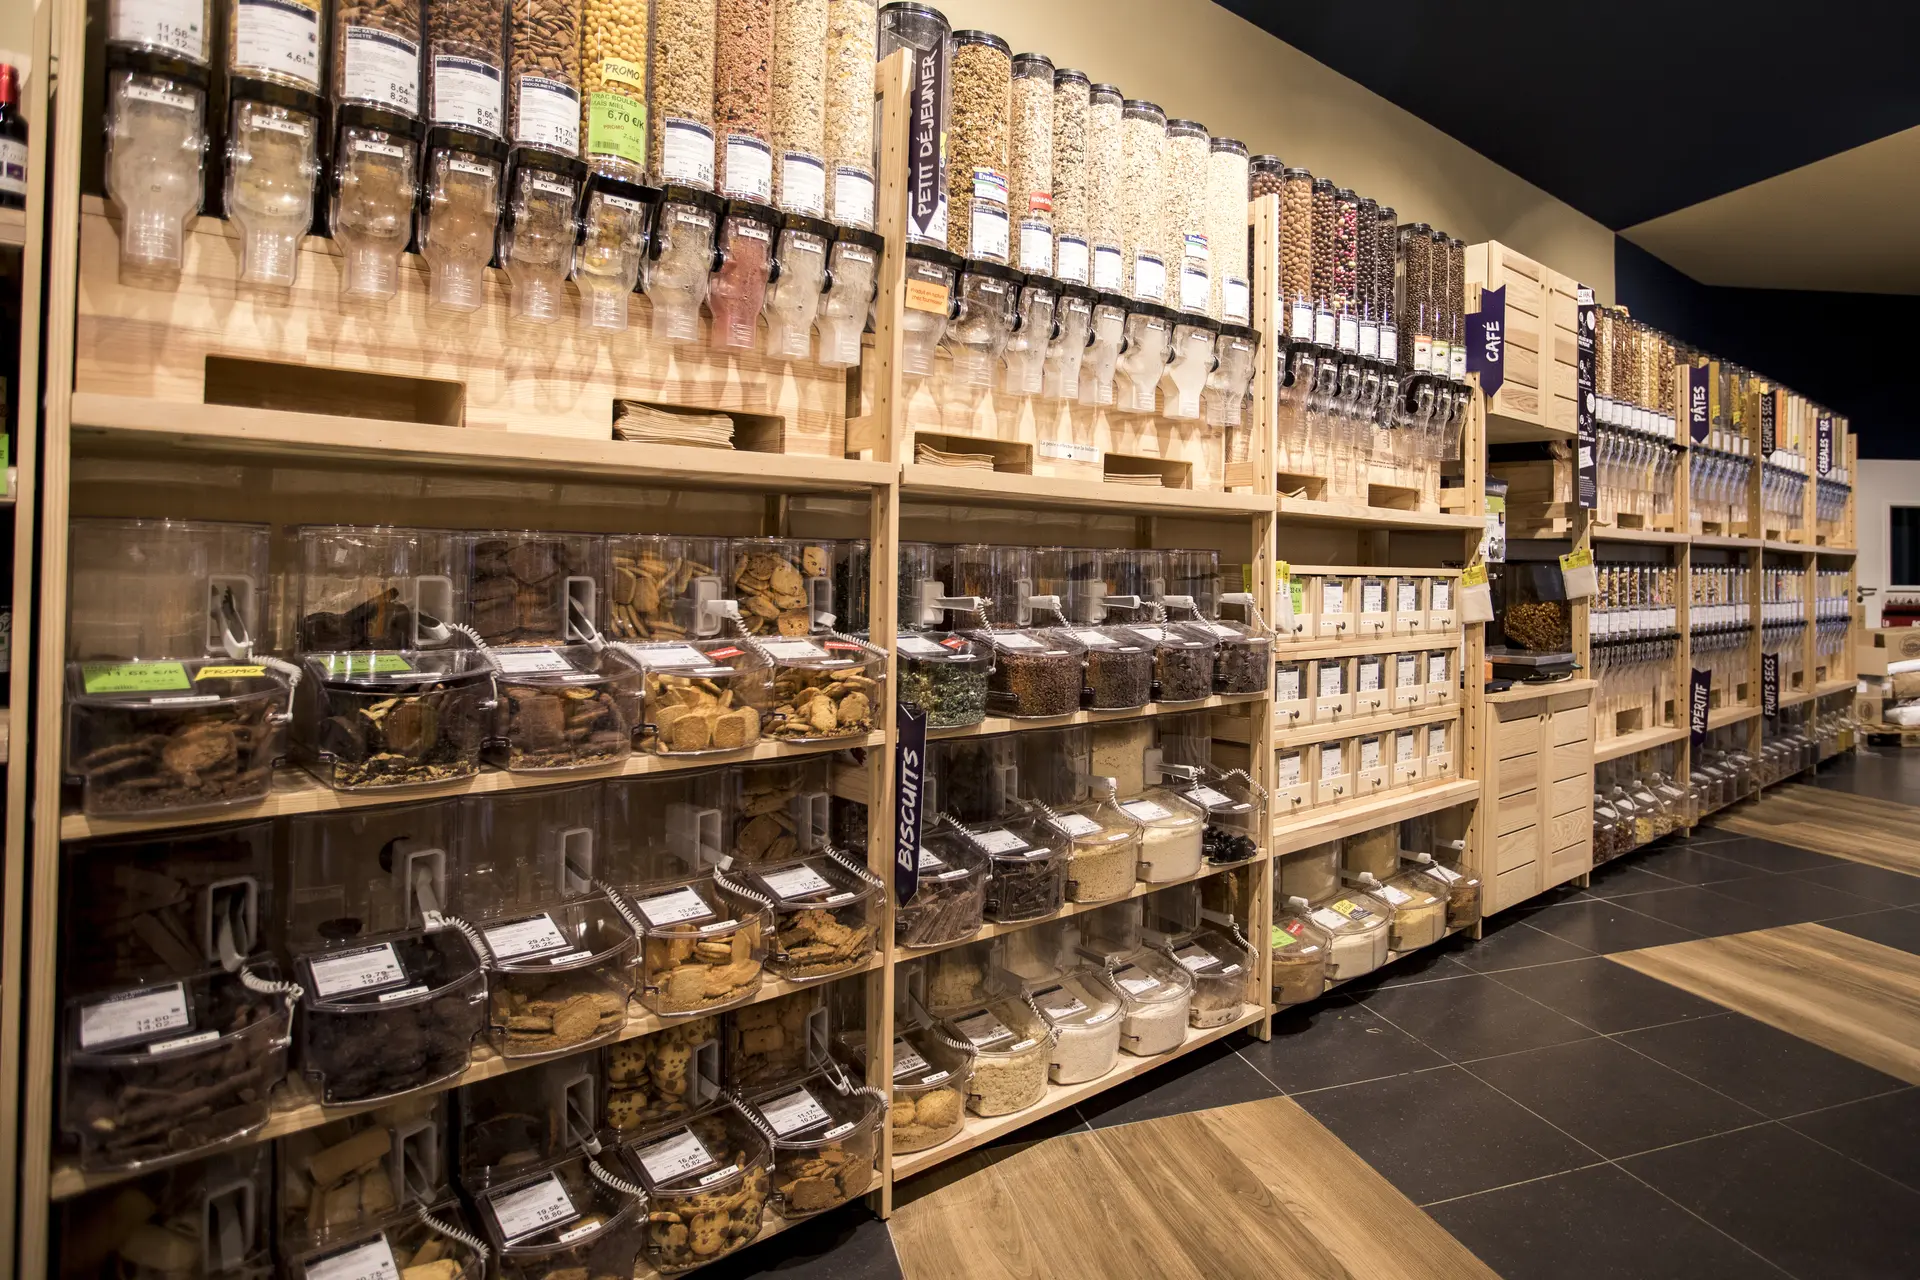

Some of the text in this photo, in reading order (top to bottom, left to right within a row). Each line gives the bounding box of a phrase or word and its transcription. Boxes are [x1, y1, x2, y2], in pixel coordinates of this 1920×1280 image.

[157, 22, 188, 39] 11,58
[156, 33, 188, 48] 11,12
[286, 51, 307, 65] 4,61
[604, 62, 641, 81] PROMO
[390, 82, 409, 96] 8,64
[390, 91, 409, 105] 8,29
[611, 94, 638, 108] BOULES
[608, 101, 625, 110] MIEL
[477, 107, 493, 121] 8,60
[607, 109, 630, 123] 6,70
[477, 116, 493, 130] 8,26
[916, 47, 938, 218] PETIT DÉJEUNER
[1481, 320, 1502, 363] CAFÉ
[1690, 385, 1707, 423] PÂTES
[1762, 396, 1773, 416] SECS
[1764, 657, 1777, 717] FRUITS SECS
[1690, 682, 1708, 734] APÉRITIF
[897, 745, 920, 873] BISCUITS
[527, 936, 551, 945] 29,43
[530, 941, 555, 950] 28,25
[361, 976, 389, 985] 19,00
[136, 1015, 170, 1026] 14,60
[138, 1021, 170, 1032] 14,02
[797, 1110, 814, 1119] 11,17
[800, 1114, 818, 1124] 10,72
[677, 1154, 699, 1165] 16,48
[681, 1159, 702, 1169] 15,82
[536, 1204, 560, 1217] 19,58
[540, 1209, 563, 1222] 18,80
